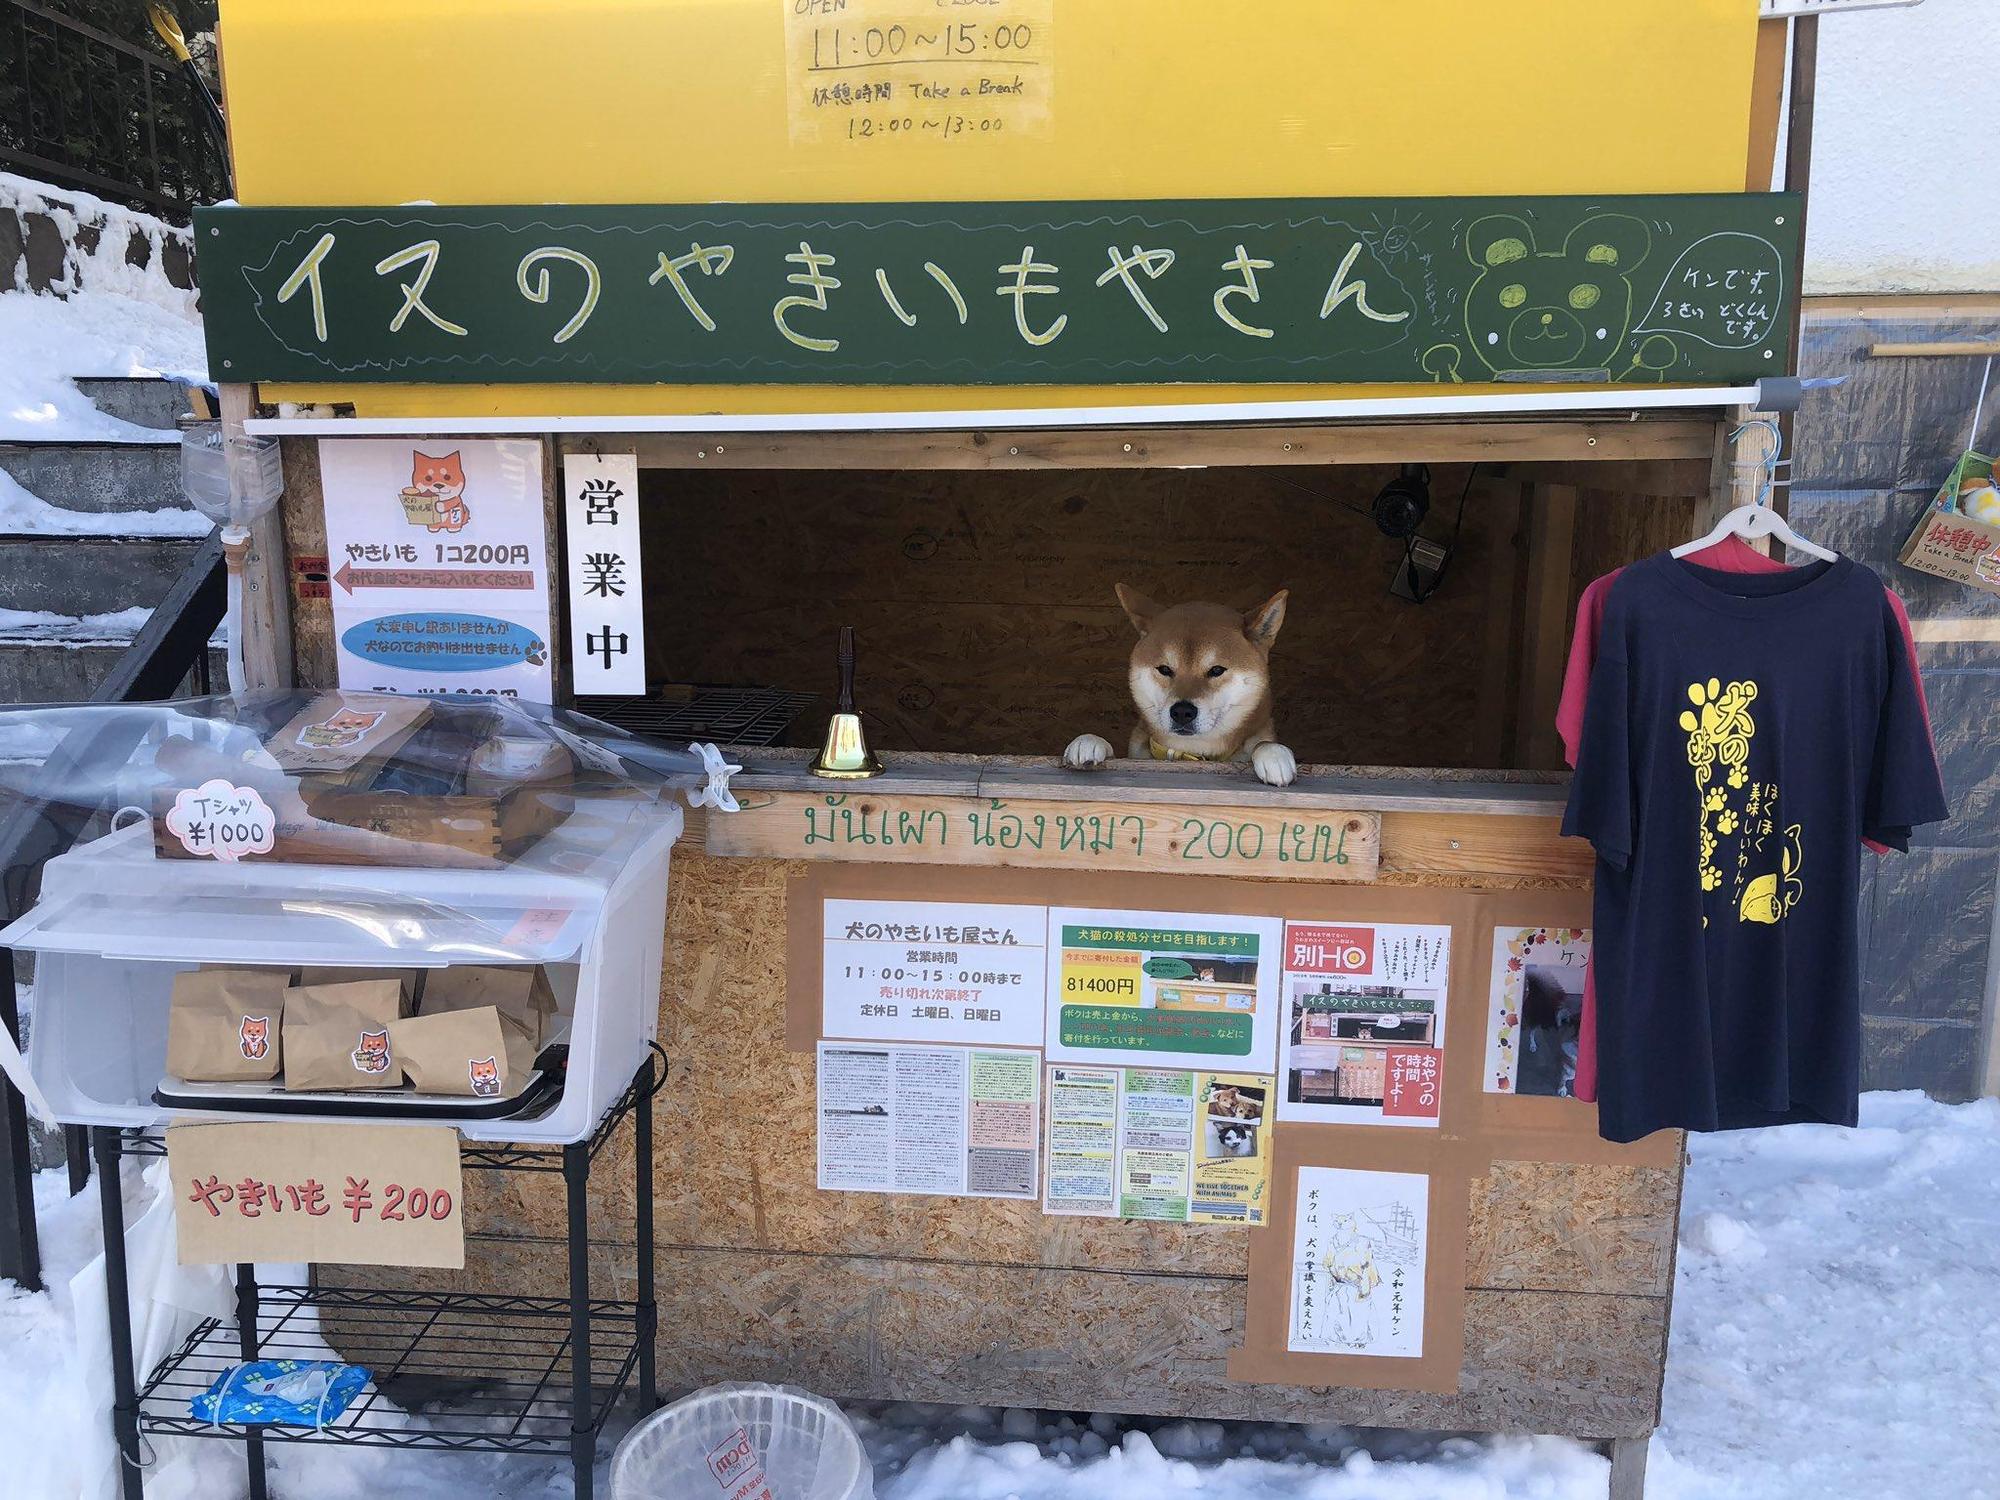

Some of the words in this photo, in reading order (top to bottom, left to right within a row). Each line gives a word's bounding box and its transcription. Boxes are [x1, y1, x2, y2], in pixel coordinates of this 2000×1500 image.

[812, 83, 892, 107] 休憩時間
[909, 82, 950, 99] Take
[960, 87, 971, 96] a
[978, 75, 1024, 96] Break
[345, 543, 419, 563] やきいも
[434, 544, 530, 565] 1コ200円
[1923, 543, 1942, 557] Take
[1952, 552, 1976, 566] Break
[347, 571, 532, 587] お代金はこちらに入れてください
[578, 478, 629, 670] 営業中
[375, 620, 510, 636] 大変申し訳ありませんが
[364, 639, 522, 656] 犬なのでお釣りは出せません
[1755, 783, 1779, 853] ほくほく
[1182, 818, 1264, 862] 200
[1731, 781, 1762, 905] 美味しいわん！
[845, 920, 1019, 946] 犬のやきいも屋さん
[1078, 928, 1250, 948] 犬猫の殺処分ゼロを目指します！
[906, 949, 958, 965] 営業時間
[879, 985, 983, 1002] 売り切れ次第終了
[1066, 977, 1135, 995] 81400円
[860, 1003, 899, 1018] 定休日
[911, 1006, 1002, 1022] 土曜日、日曜日
[1063, 1033, 1151, 1047] 寄付を行っています。
[1390, 1053, 1407, 1108] ですよ！
[1405, 1054, 1422, 1083] 時間
[1419, 1054, 1438, 1107] おやつの
[188, 1174, 331, 1218] やきいも
[1301, 1189, 1320, 1341] ボクは、犬の常識を変えたい
